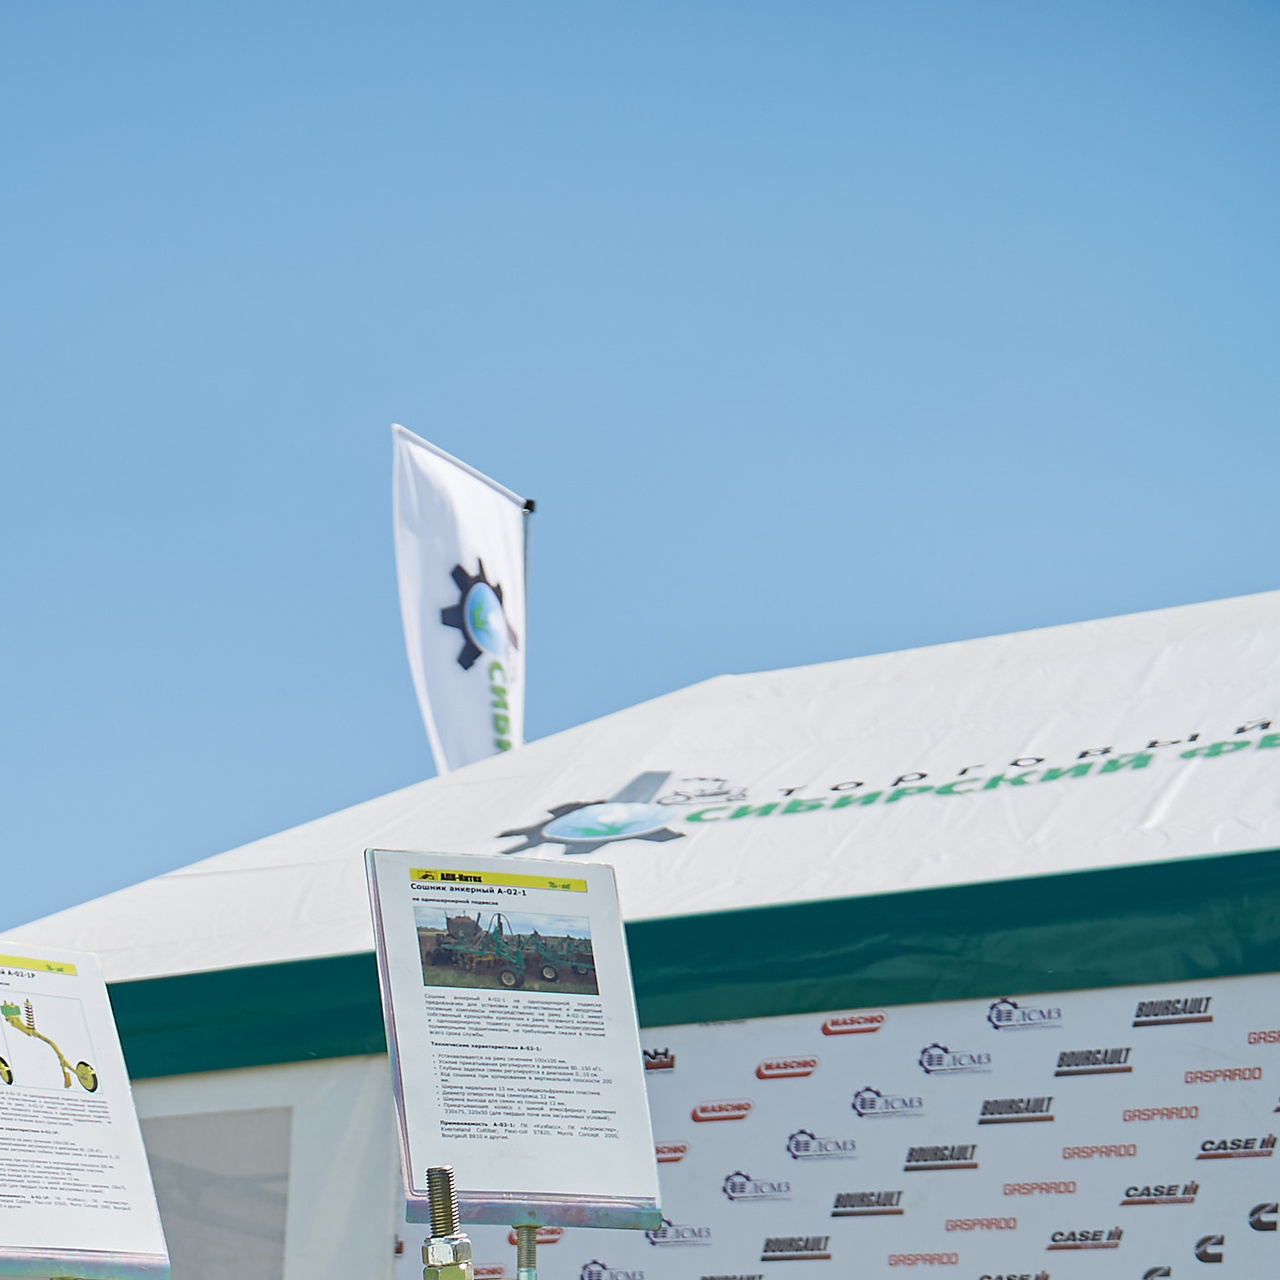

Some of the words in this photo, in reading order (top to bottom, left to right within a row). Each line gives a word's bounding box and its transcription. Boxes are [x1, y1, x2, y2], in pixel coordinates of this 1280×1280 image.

[410, 883, 447, 891] Сошник
[449, 885, 494, 894] анкерный
[830, 1014, 884, 1027] MASCHIO
[643, 1048, 669, 1062] NH
[764, 1059, 817, 1071] MASCHIO
[1185, 1067, 1262, 1084] GASPARDO
[700, 1102, 751, 1114] MASCHIO
[1123, 1106, 1199, 1122] GASPARDO
[1063, 1144, 1137, 1159] GASPARDO
[1201, 1137, 1257, 1152] CASE
[1003, 1181, 1076, 1196] GASPARDO
[1125, 1184, 1180, 1198] CASE
[945, 1217, 1017, 1231] GASPARDO
[1051, 1230, 1103, 1243] CASE
[888, 1253, 958, 1266] GASPARDO
